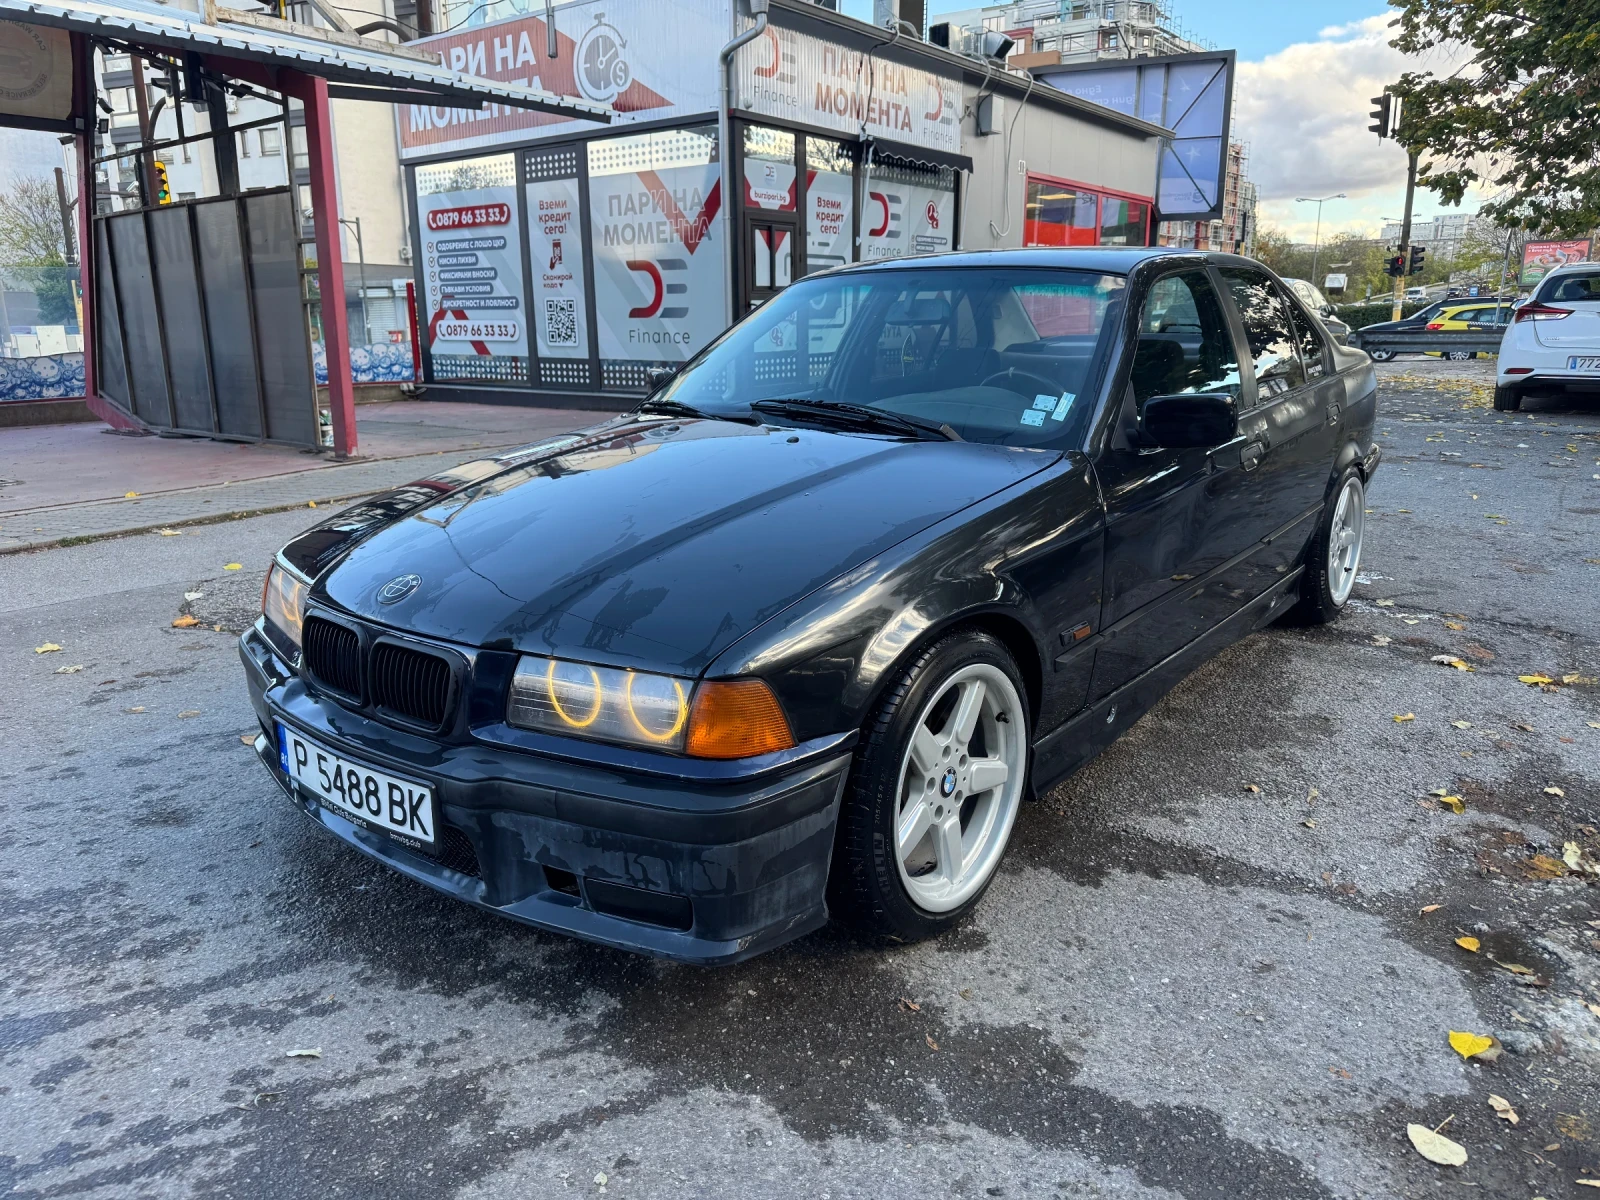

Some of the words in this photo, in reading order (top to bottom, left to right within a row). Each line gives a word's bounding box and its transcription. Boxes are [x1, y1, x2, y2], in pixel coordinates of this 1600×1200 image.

[437, 40, 487, 77] РИ
[494, 30, 537, 73] НА
[823, 46, 876, 86] ПАРИ
[882, 64, 908, 97] НА
[753, 85, 798, 107] Finance
[814, 82, 912, 133] МОМЕНТА
[923, 127, 953, 144] Finance
[608, 189, 666, 217] ПАРИ
[672, 187, 705, 213] НА
[754, 190, 787, 203] burzipari.bg
[817, 196, 842, 210] Вземи
[540, 200, 567, 210] Вземи
[436, 211, 459, 227] 0879
[461, 210, 473, 224] 66
[474, 209, 487, 223] 33
[488, 208, 500, 221] 33
[538, 212, 572, 223] кредит
[816, 210, 845, 225] кредит
[544, 223, 567, 235] сега!
[603, 216, 713, 246] МОМЕНТА
[820, 223, 840, 235] сега!
[437, 241, 469, 252] ОДОБРЕНИЕ
[474, 239, 492, 249] ЛОШО
[868, 245, 901, 258] Finance
[472, 270, 495, 279] ВНОСКИ
[542, 273, 573, 281] Сканирай
[465, 284, 491, 293] УСЛОВИЯ
[446, 325, 468, 337] 0879
[470, 324, 482, 336] 66
[484, 324, 495, 336] 33
[498, 324, 509, 336] 33
[629, 328, 690, 344] Finance
[293, 738, 308, 777] P
[316, 753, 381, 816] 5488
[388, 782, 430, 836] BK
